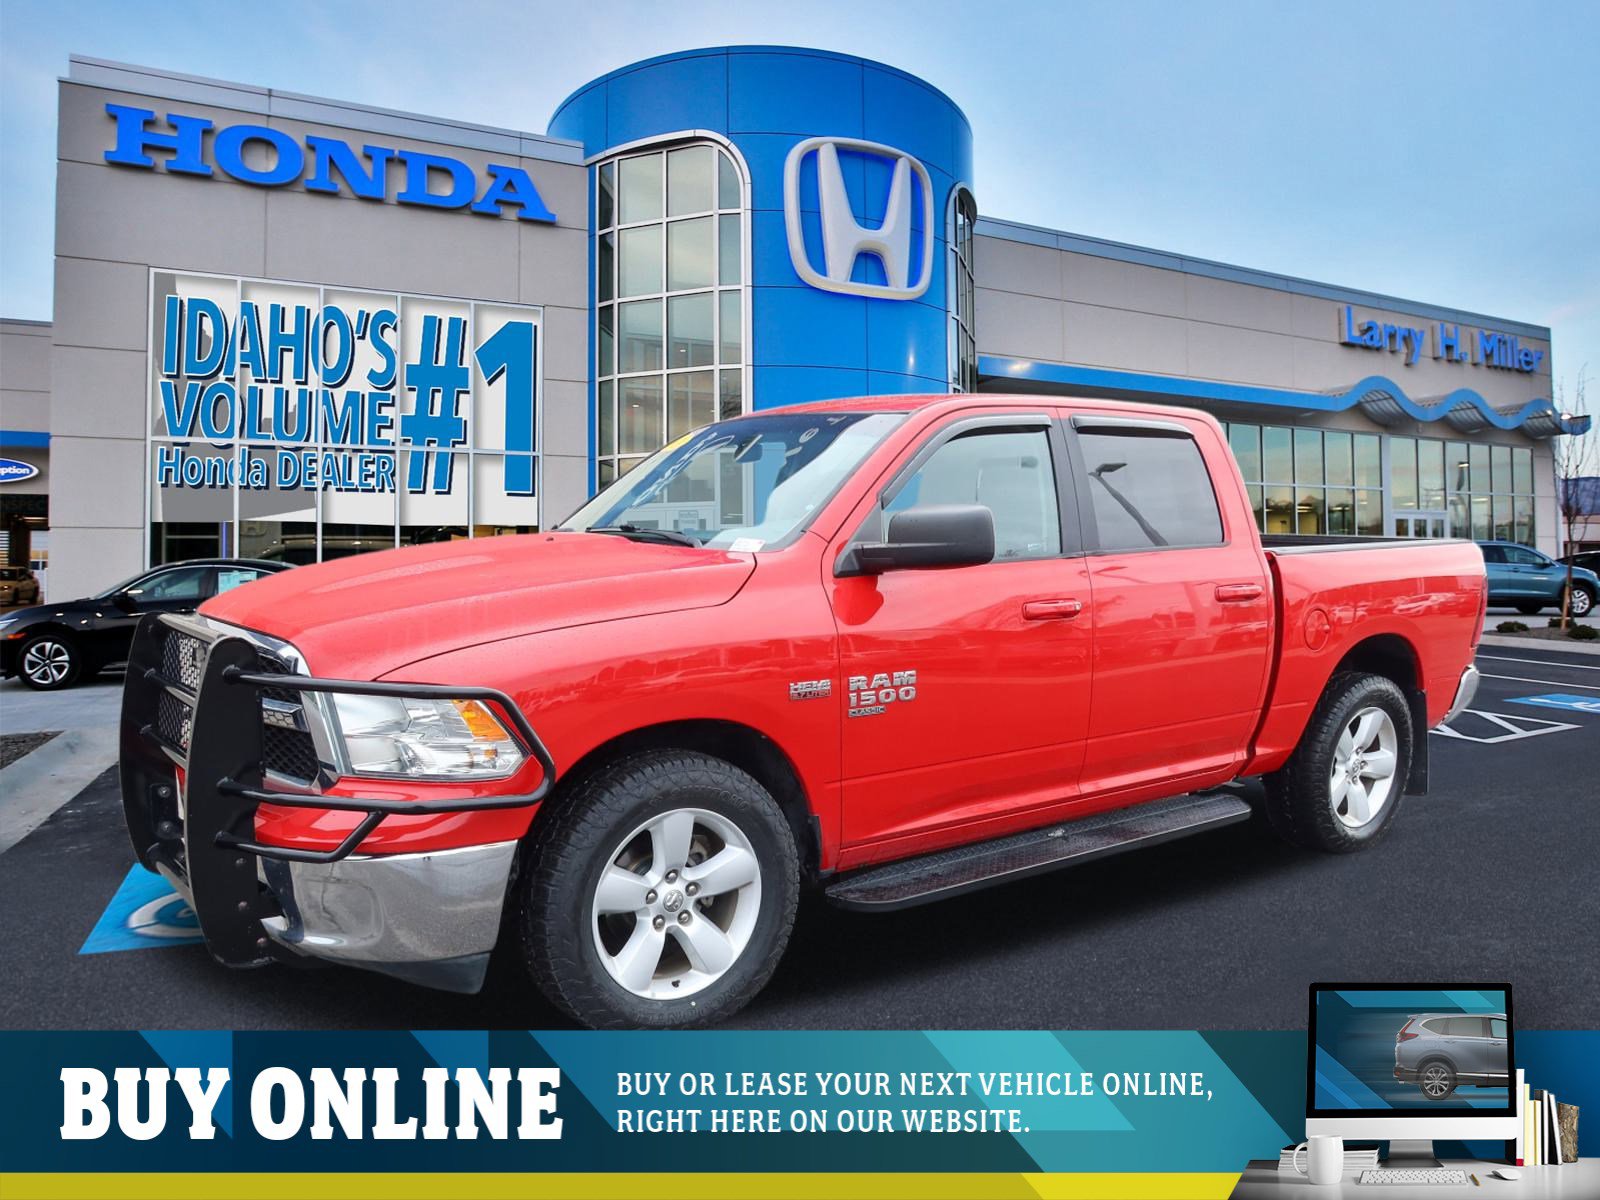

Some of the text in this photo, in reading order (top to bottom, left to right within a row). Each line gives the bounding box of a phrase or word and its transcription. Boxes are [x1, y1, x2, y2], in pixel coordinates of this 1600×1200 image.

[104, 103, 557, 224] HONDA
[163, 295, 398, 389] IDAHO'S
[1340, 305, 1545, 373] Larry H. Miller
[159, 380, 397, 449] VOLUME
[401, 314, 538, 497] #1
[157, 447, 396, 493] Honda DEALER
[848, 670, 917, 690] RAM
[848, 686, 917, 707] 1500
